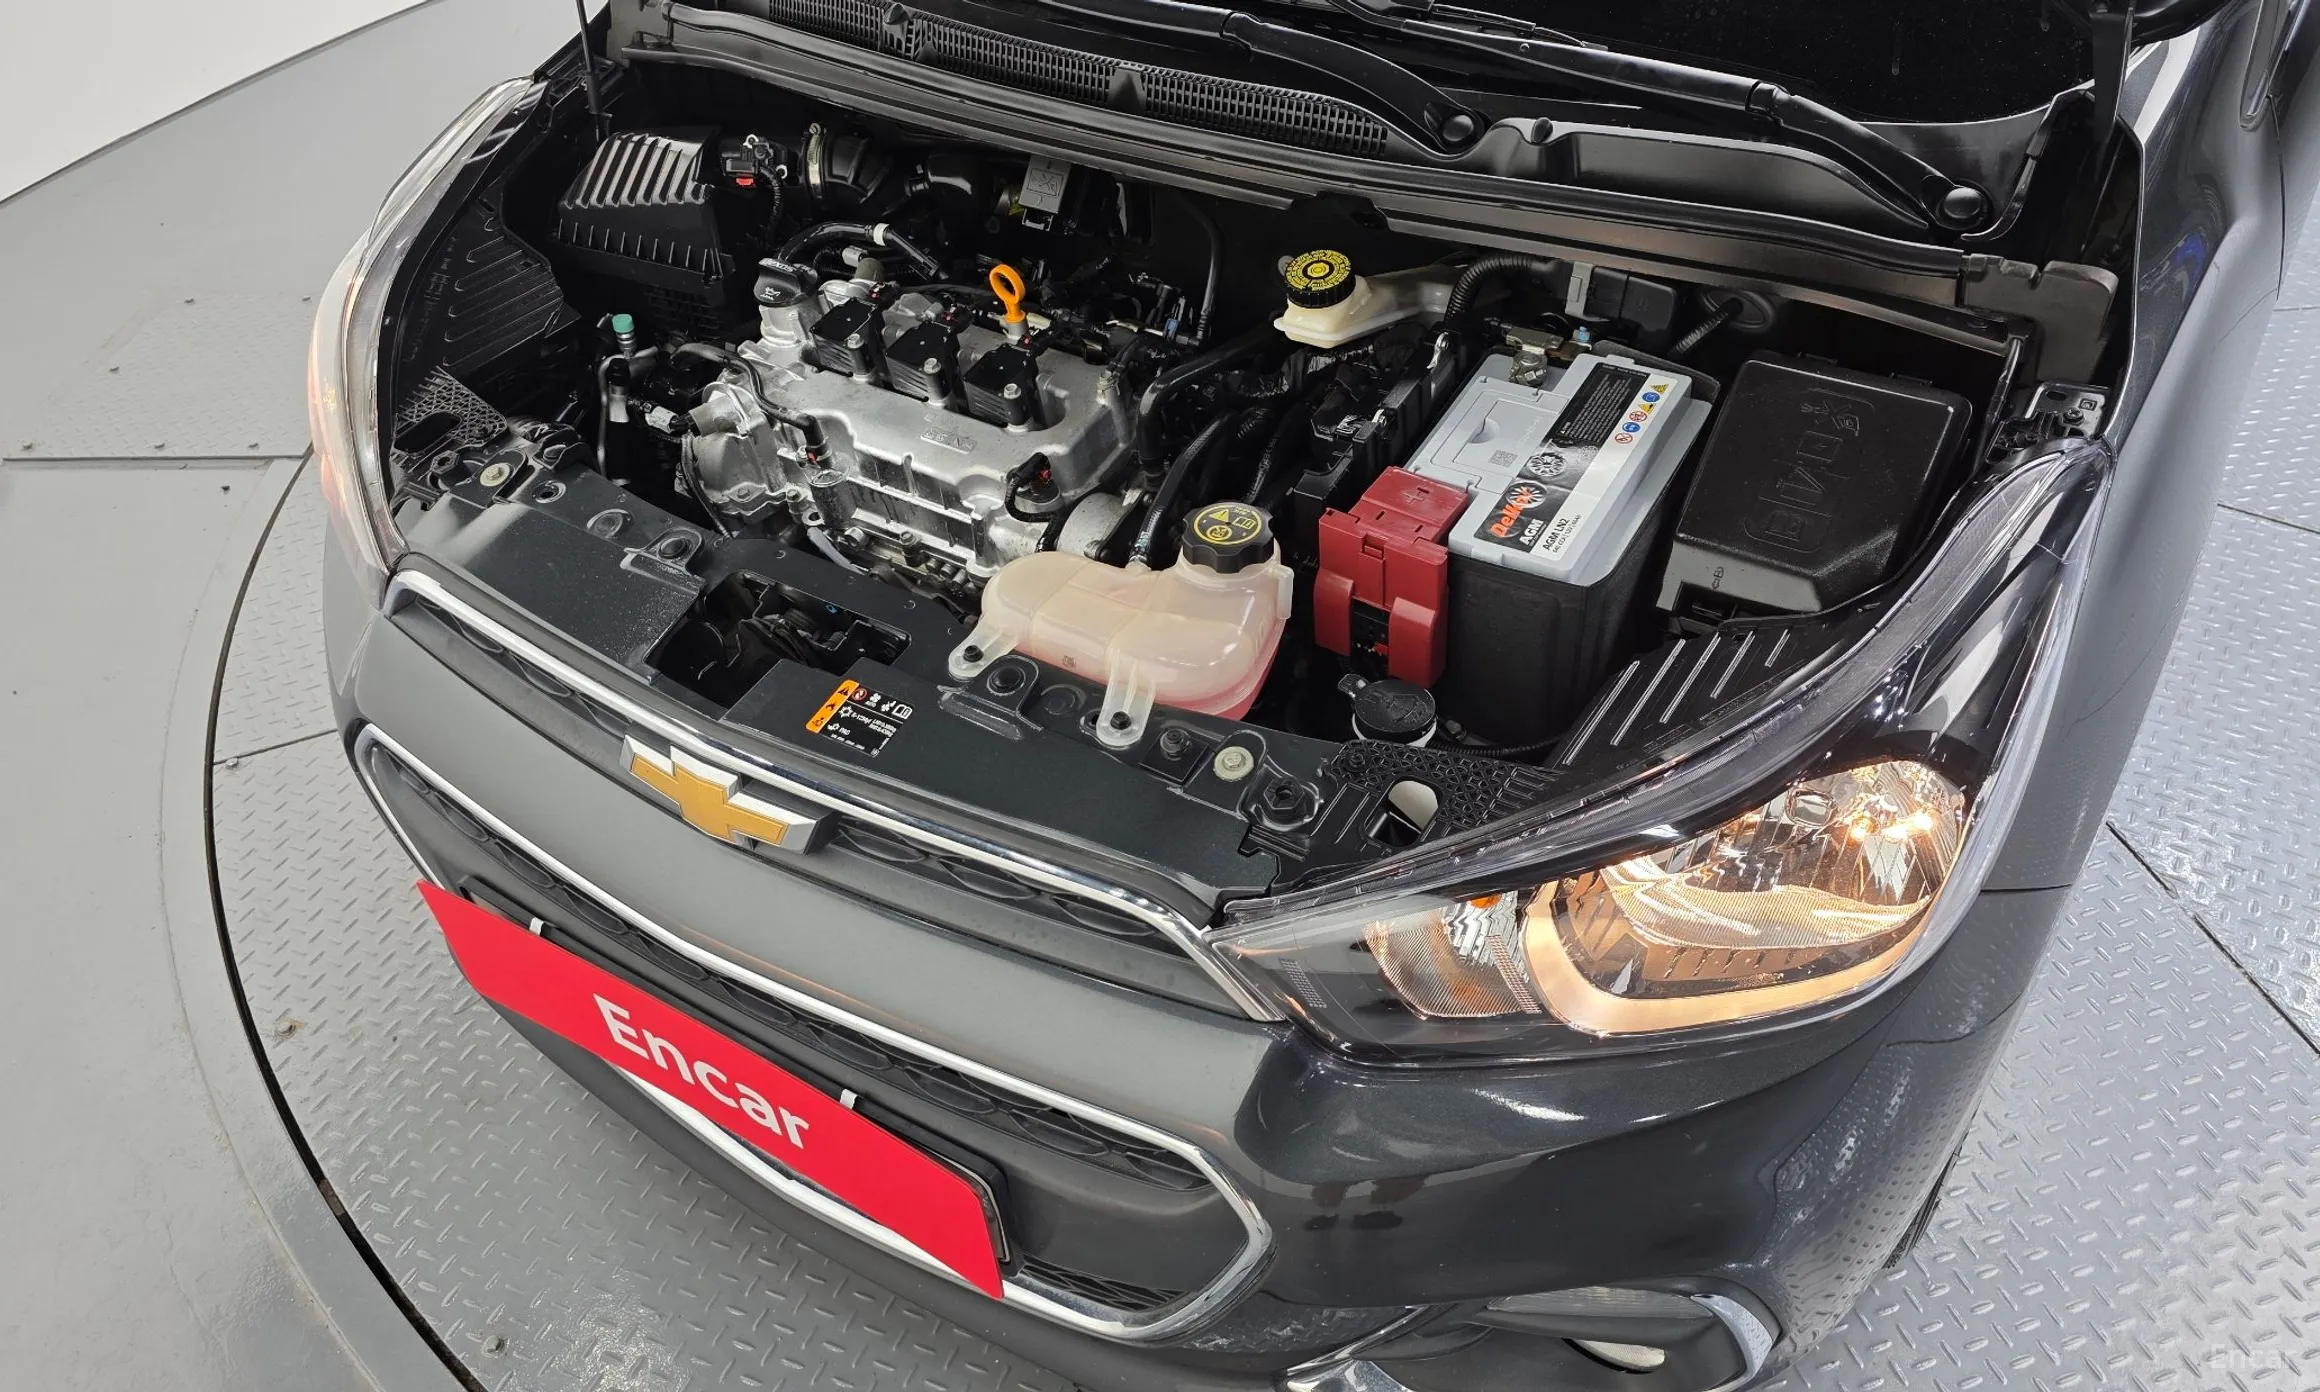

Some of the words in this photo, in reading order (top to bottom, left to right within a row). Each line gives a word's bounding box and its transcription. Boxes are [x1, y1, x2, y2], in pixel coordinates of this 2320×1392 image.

[1519, 518, 1545, 546] AGM
[1542, 531, 1561, 551] AGM
[1553, 518, 1570, 532] LN2
[593, 993, 809, 1149] Encar
